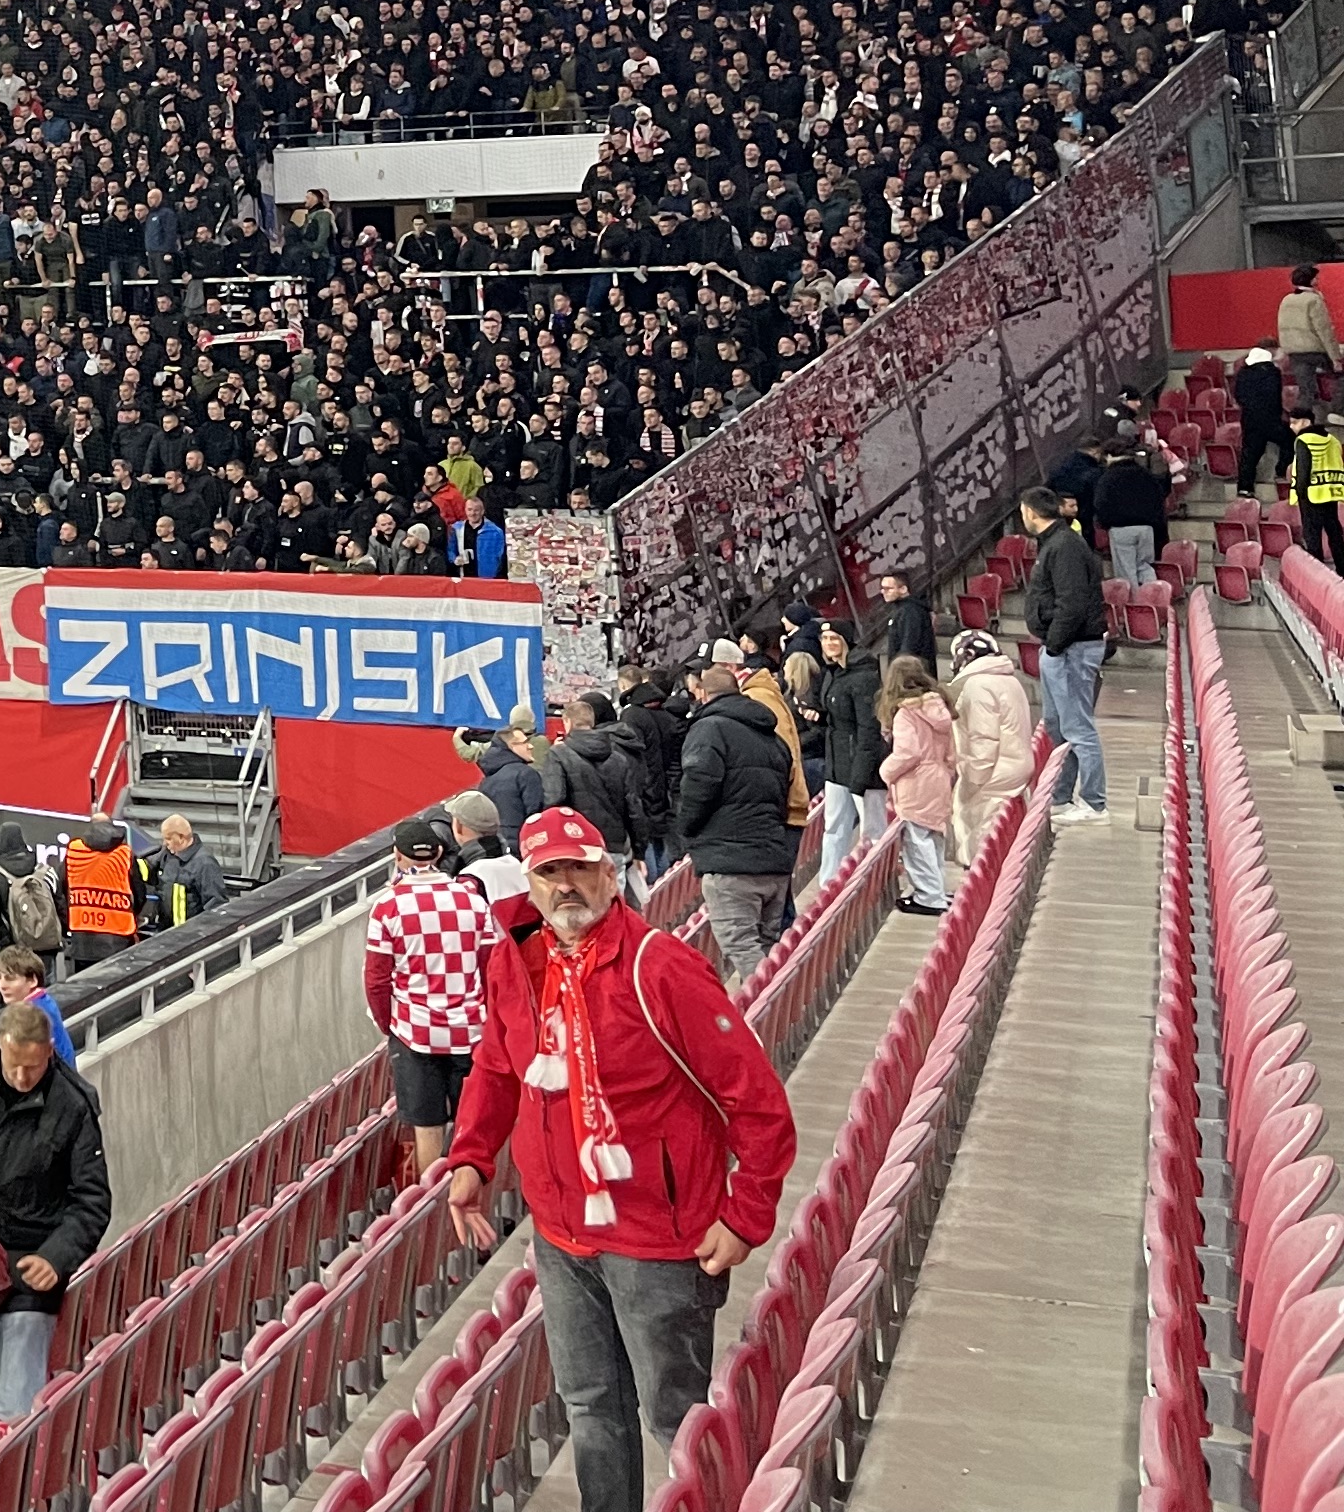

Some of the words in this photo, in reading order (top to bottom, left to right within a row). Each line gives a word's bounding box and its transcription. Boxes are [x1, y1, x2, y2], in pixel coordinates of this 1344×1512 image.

[58, 618, 531, 721] ZRINJSKI
[69, 889, 131, 909] STEWARD
[81, 911, 106, 927] 019
